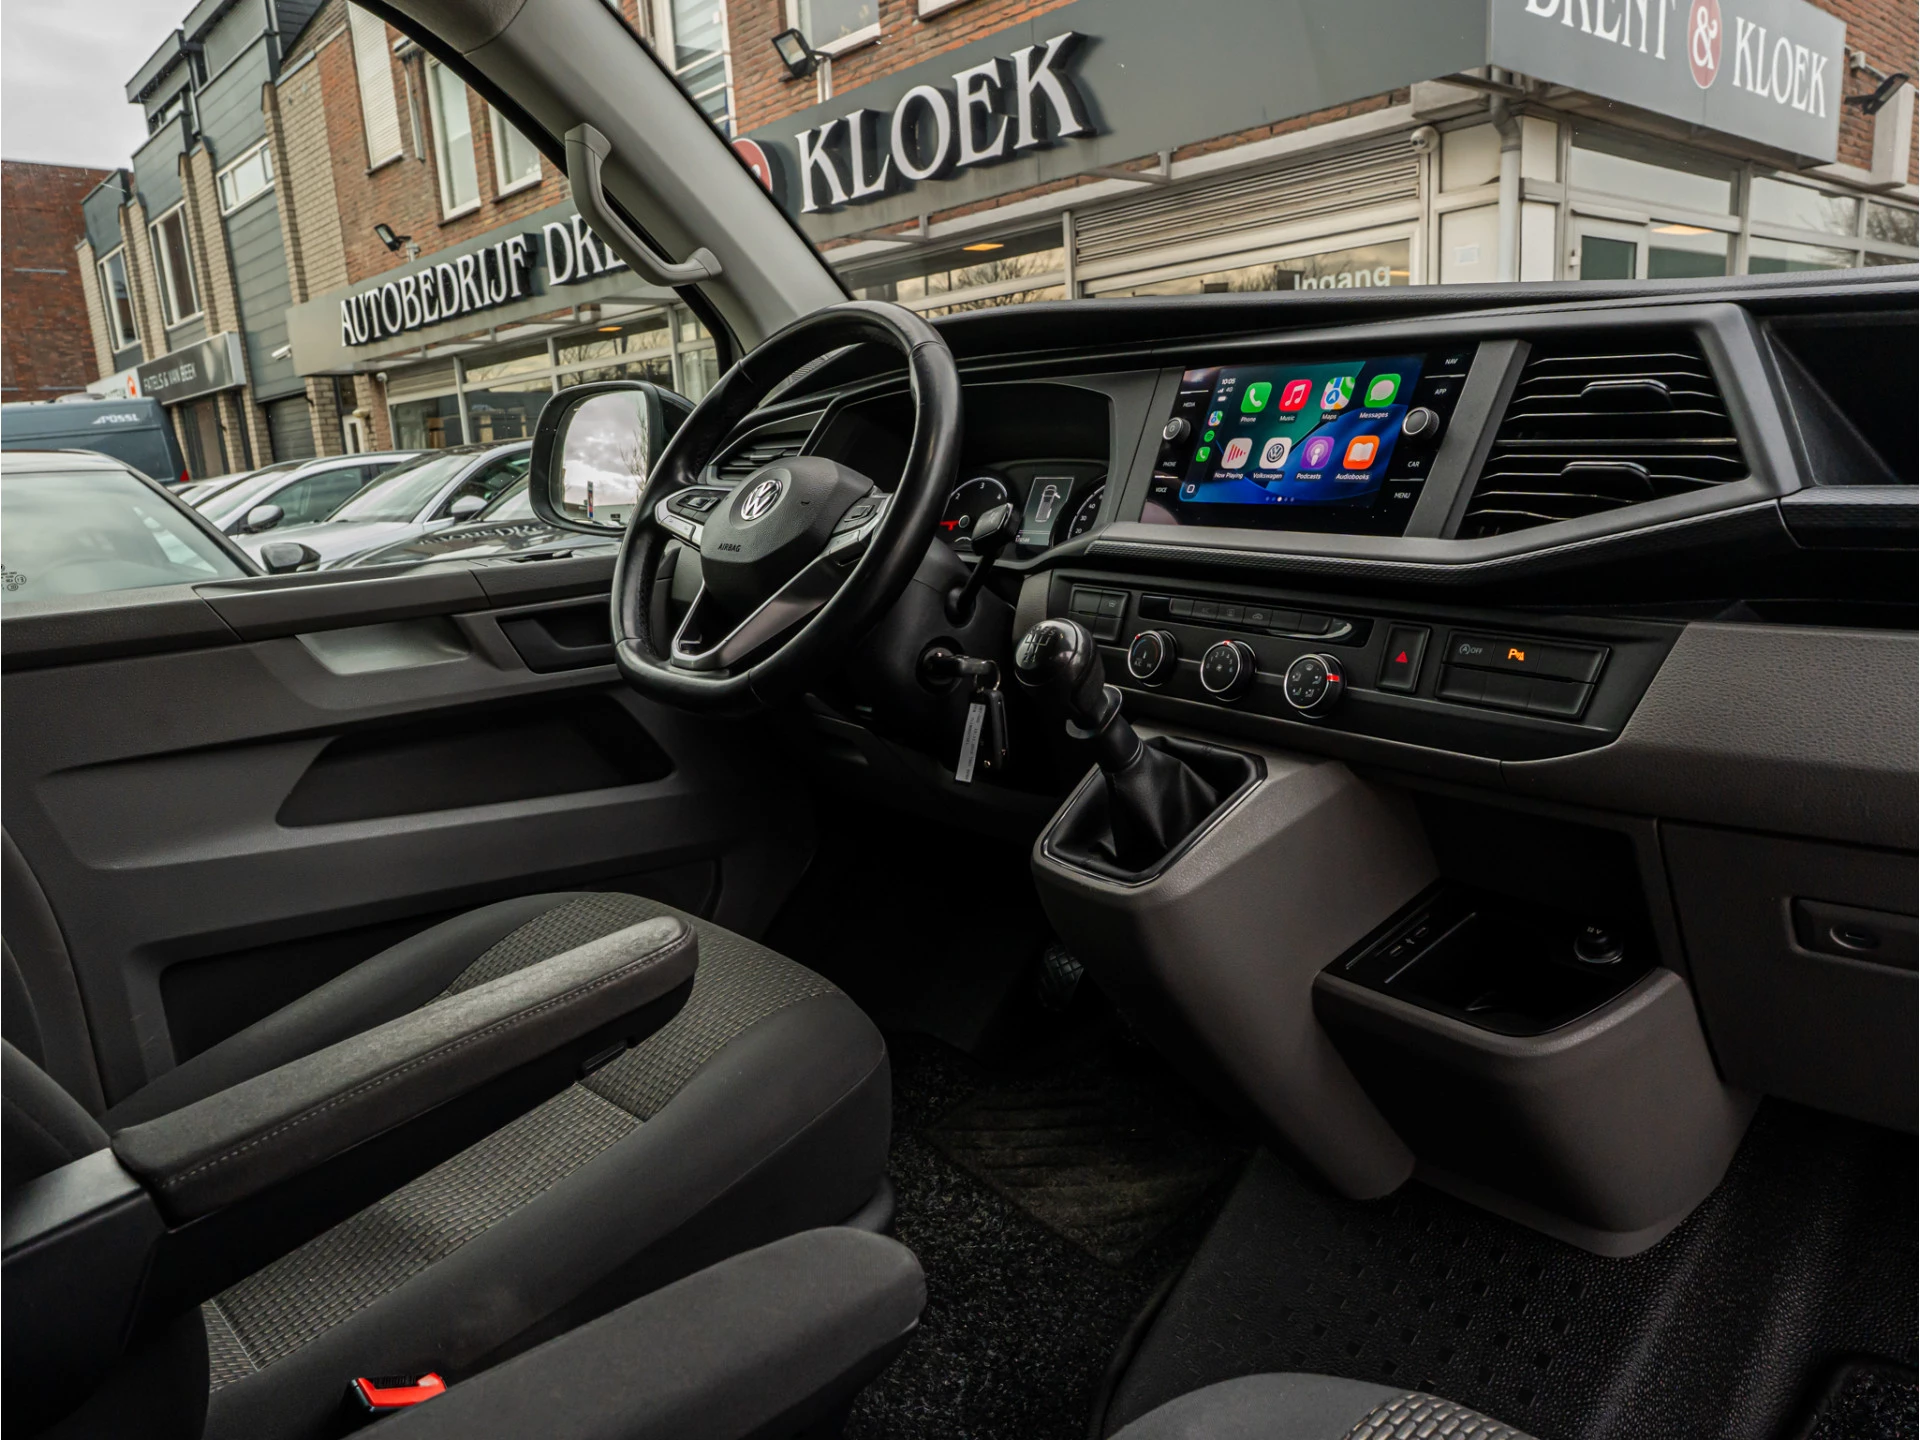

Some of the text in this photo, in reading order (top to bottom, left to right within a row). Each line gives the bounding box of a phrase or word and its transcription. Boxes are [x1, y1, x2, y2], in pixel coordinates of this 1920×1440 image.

[1692, 6, 1718, 70] &
[1732, 17, 1829, 118] KLOEK
[794, 31, 1085, 214] KLOEK
[340, 233, 529, 347] AUTOBEDRIJF
[1322, 413, 1337, 421] Maps
[1359, 411, 1389, 420] Messages
[1226, 472, 1244, 480] Playing
[1252, 472, 1283, 480] Volkswagen
[1296, 472, 1322, 480] Podcasts
[1335, 472, 1370, 480] Audiobooks
[717, 543, 741, 552] AIRBAG
